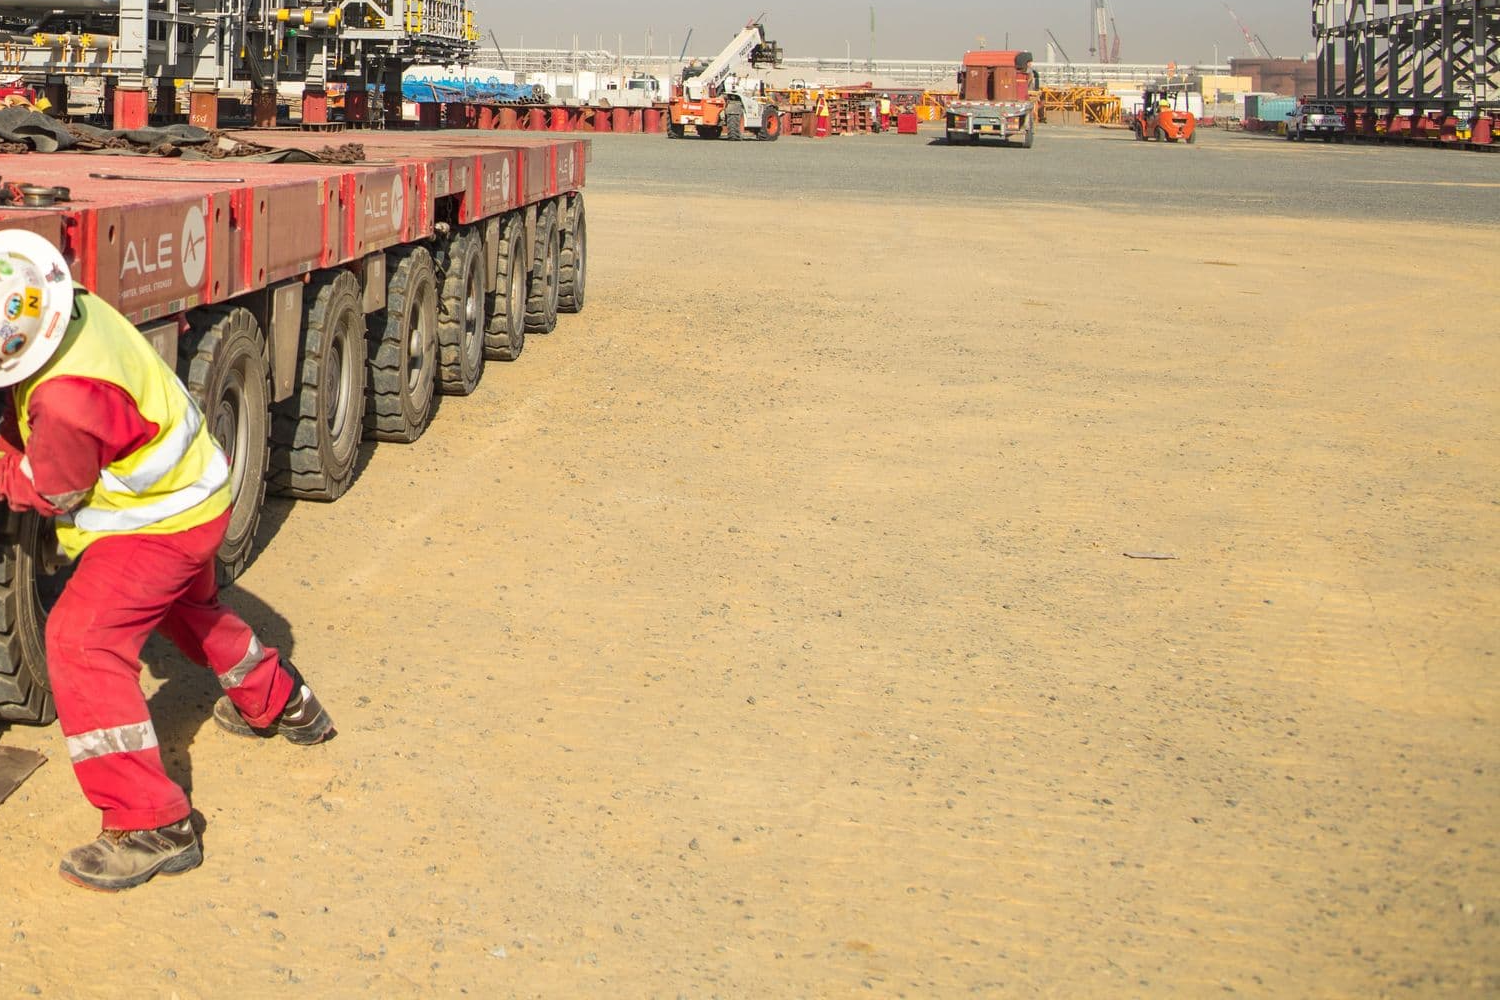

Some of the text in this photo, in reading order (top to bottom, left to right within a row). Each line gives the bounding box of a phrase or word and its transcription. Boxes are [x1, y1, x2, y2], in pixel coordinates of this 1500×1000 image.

[558, 158, 569, 174] ALE
[485, 170, 501, 193] ALE
[365, 192, 388, 219] ALE
[120, 233, 173, 279] ALE
